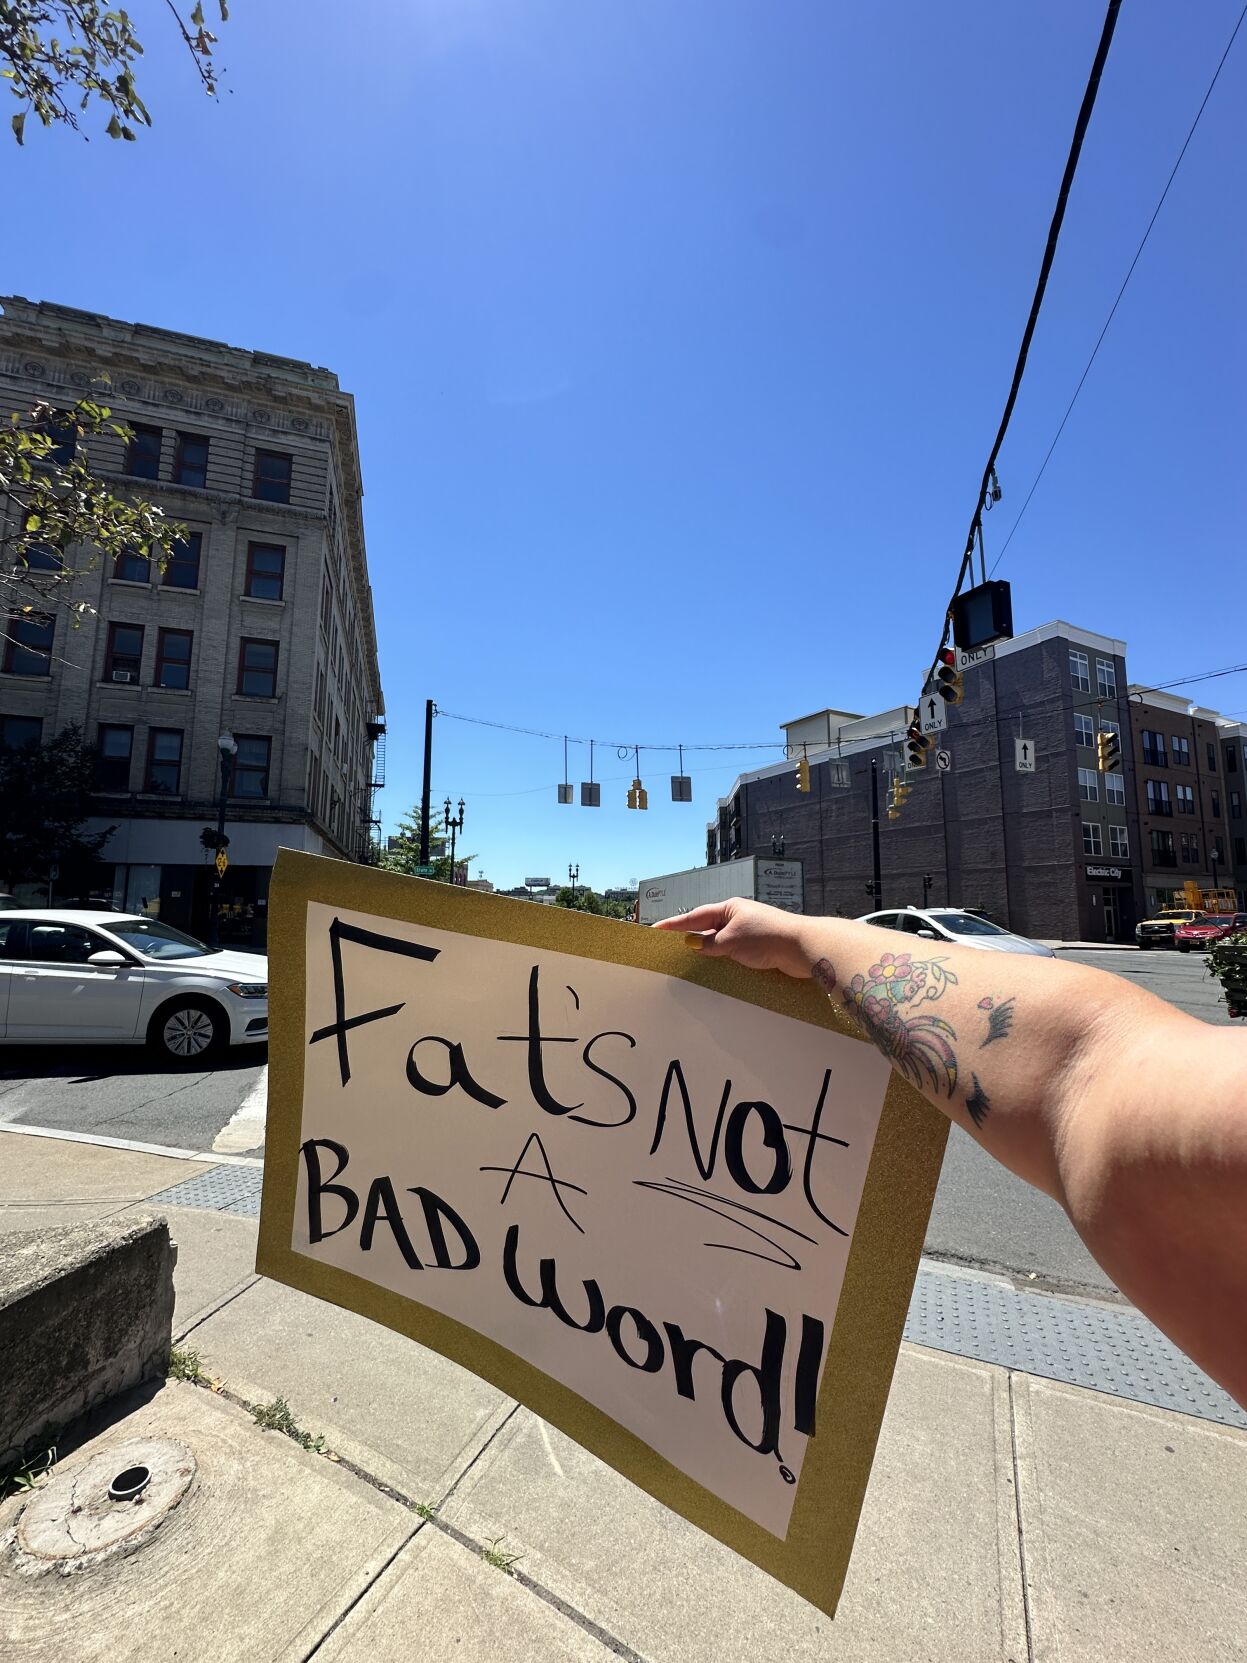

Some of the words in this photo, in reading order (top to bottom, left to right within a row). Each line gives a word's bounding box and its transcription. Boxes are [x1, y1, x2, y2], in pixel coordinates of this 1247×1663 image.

[961, 649, 989, 665] ONLY
[925, 720, 943, 731] ONLY
[1018, 761, 1033, 769] ONLY
[1110, 867, 1122, 878] City
[480, 1133, 587, 1233] A
[299, 1138, 481, 1271] BAD
